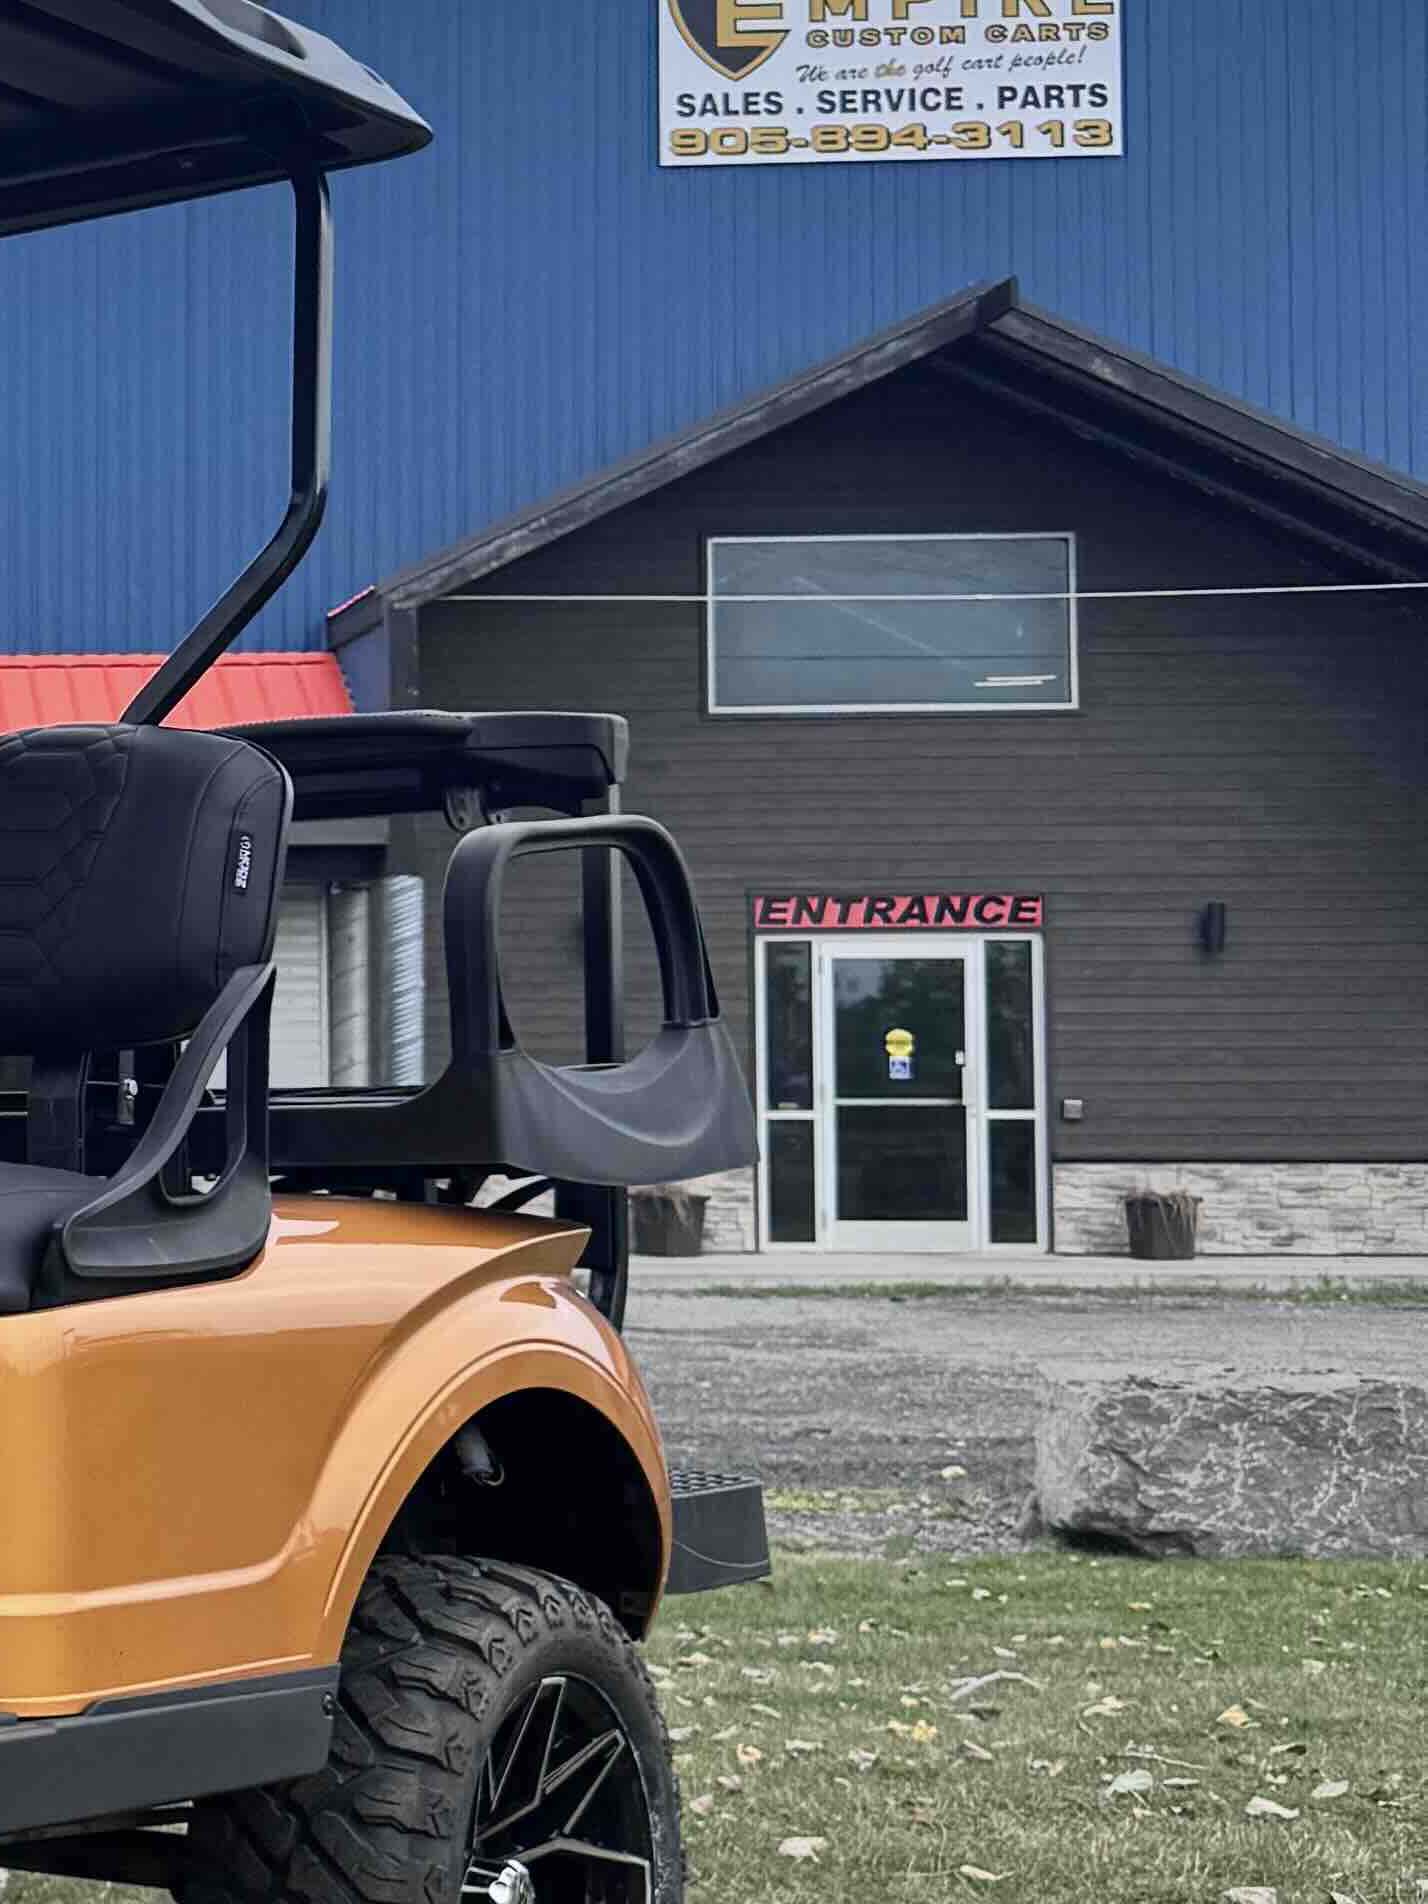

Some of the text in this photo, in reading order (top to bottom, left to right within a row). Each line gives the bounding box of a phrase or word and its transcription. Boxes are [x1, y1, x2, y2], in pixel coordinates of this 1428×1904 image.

[805, 21, 1111, 49] CUSTOM CARTS
[795, 45, 1088, 84] We are the golf cart people!
[676, 90, 785, 118] SALES
[815, 86, 965, 115] SERVICE
[996, 82, 1109, 111] PARTS
[670, 118, 1114, 156] 905-894-3113
[757, 895, 1040, 925] ENTRANCE
